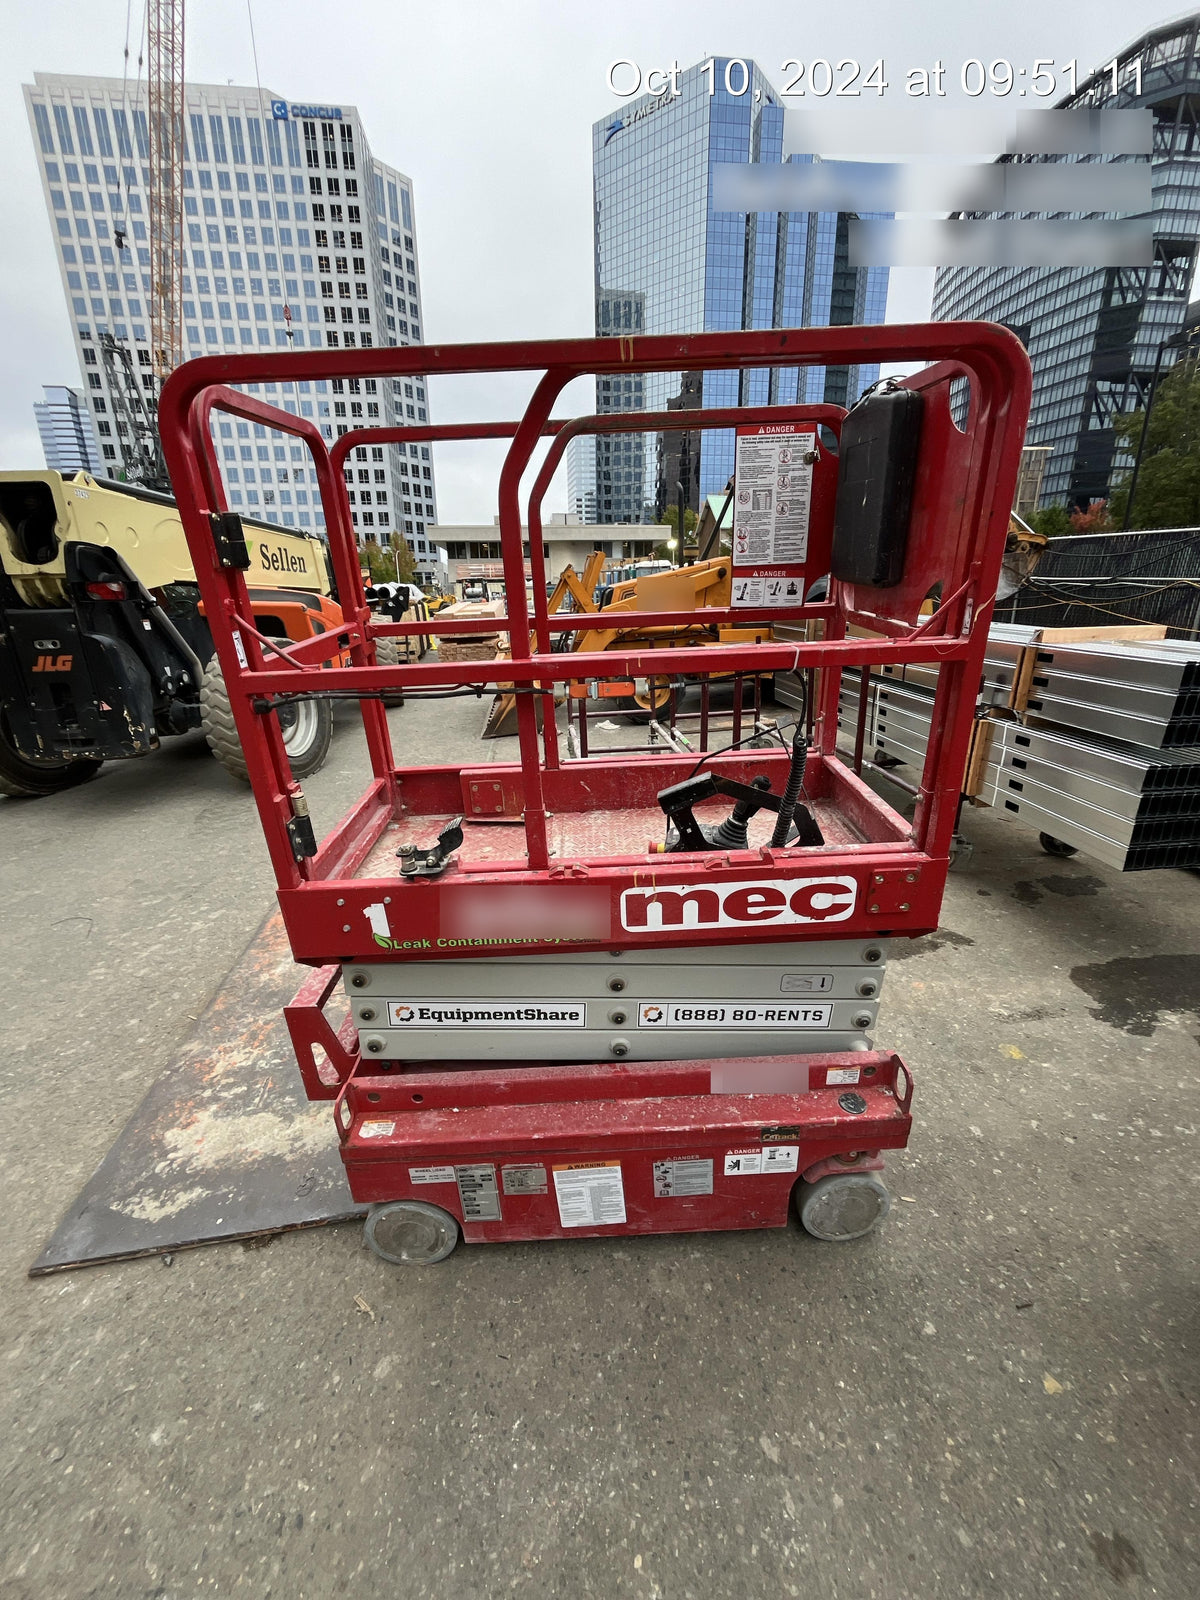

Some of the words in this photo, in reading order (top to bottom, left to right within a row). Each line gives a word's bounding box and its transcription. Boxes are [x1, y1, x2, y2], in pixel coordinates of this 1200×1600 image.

[291, 104, 343, 120] CONCUR
[766, 425, 795, 434] DANGER
[259, 543, 308, 574] Sellen
[31, 654, 74, 673] JLG
[625, 882, 853, 926] mec
[393, 939, 432, 950] Leak
[418, 1008, 580, 1023] EquipmentShare
[674, 1008, 726, 1022] (888)
[732, 1009, 824, 1022] 80-RENTS
